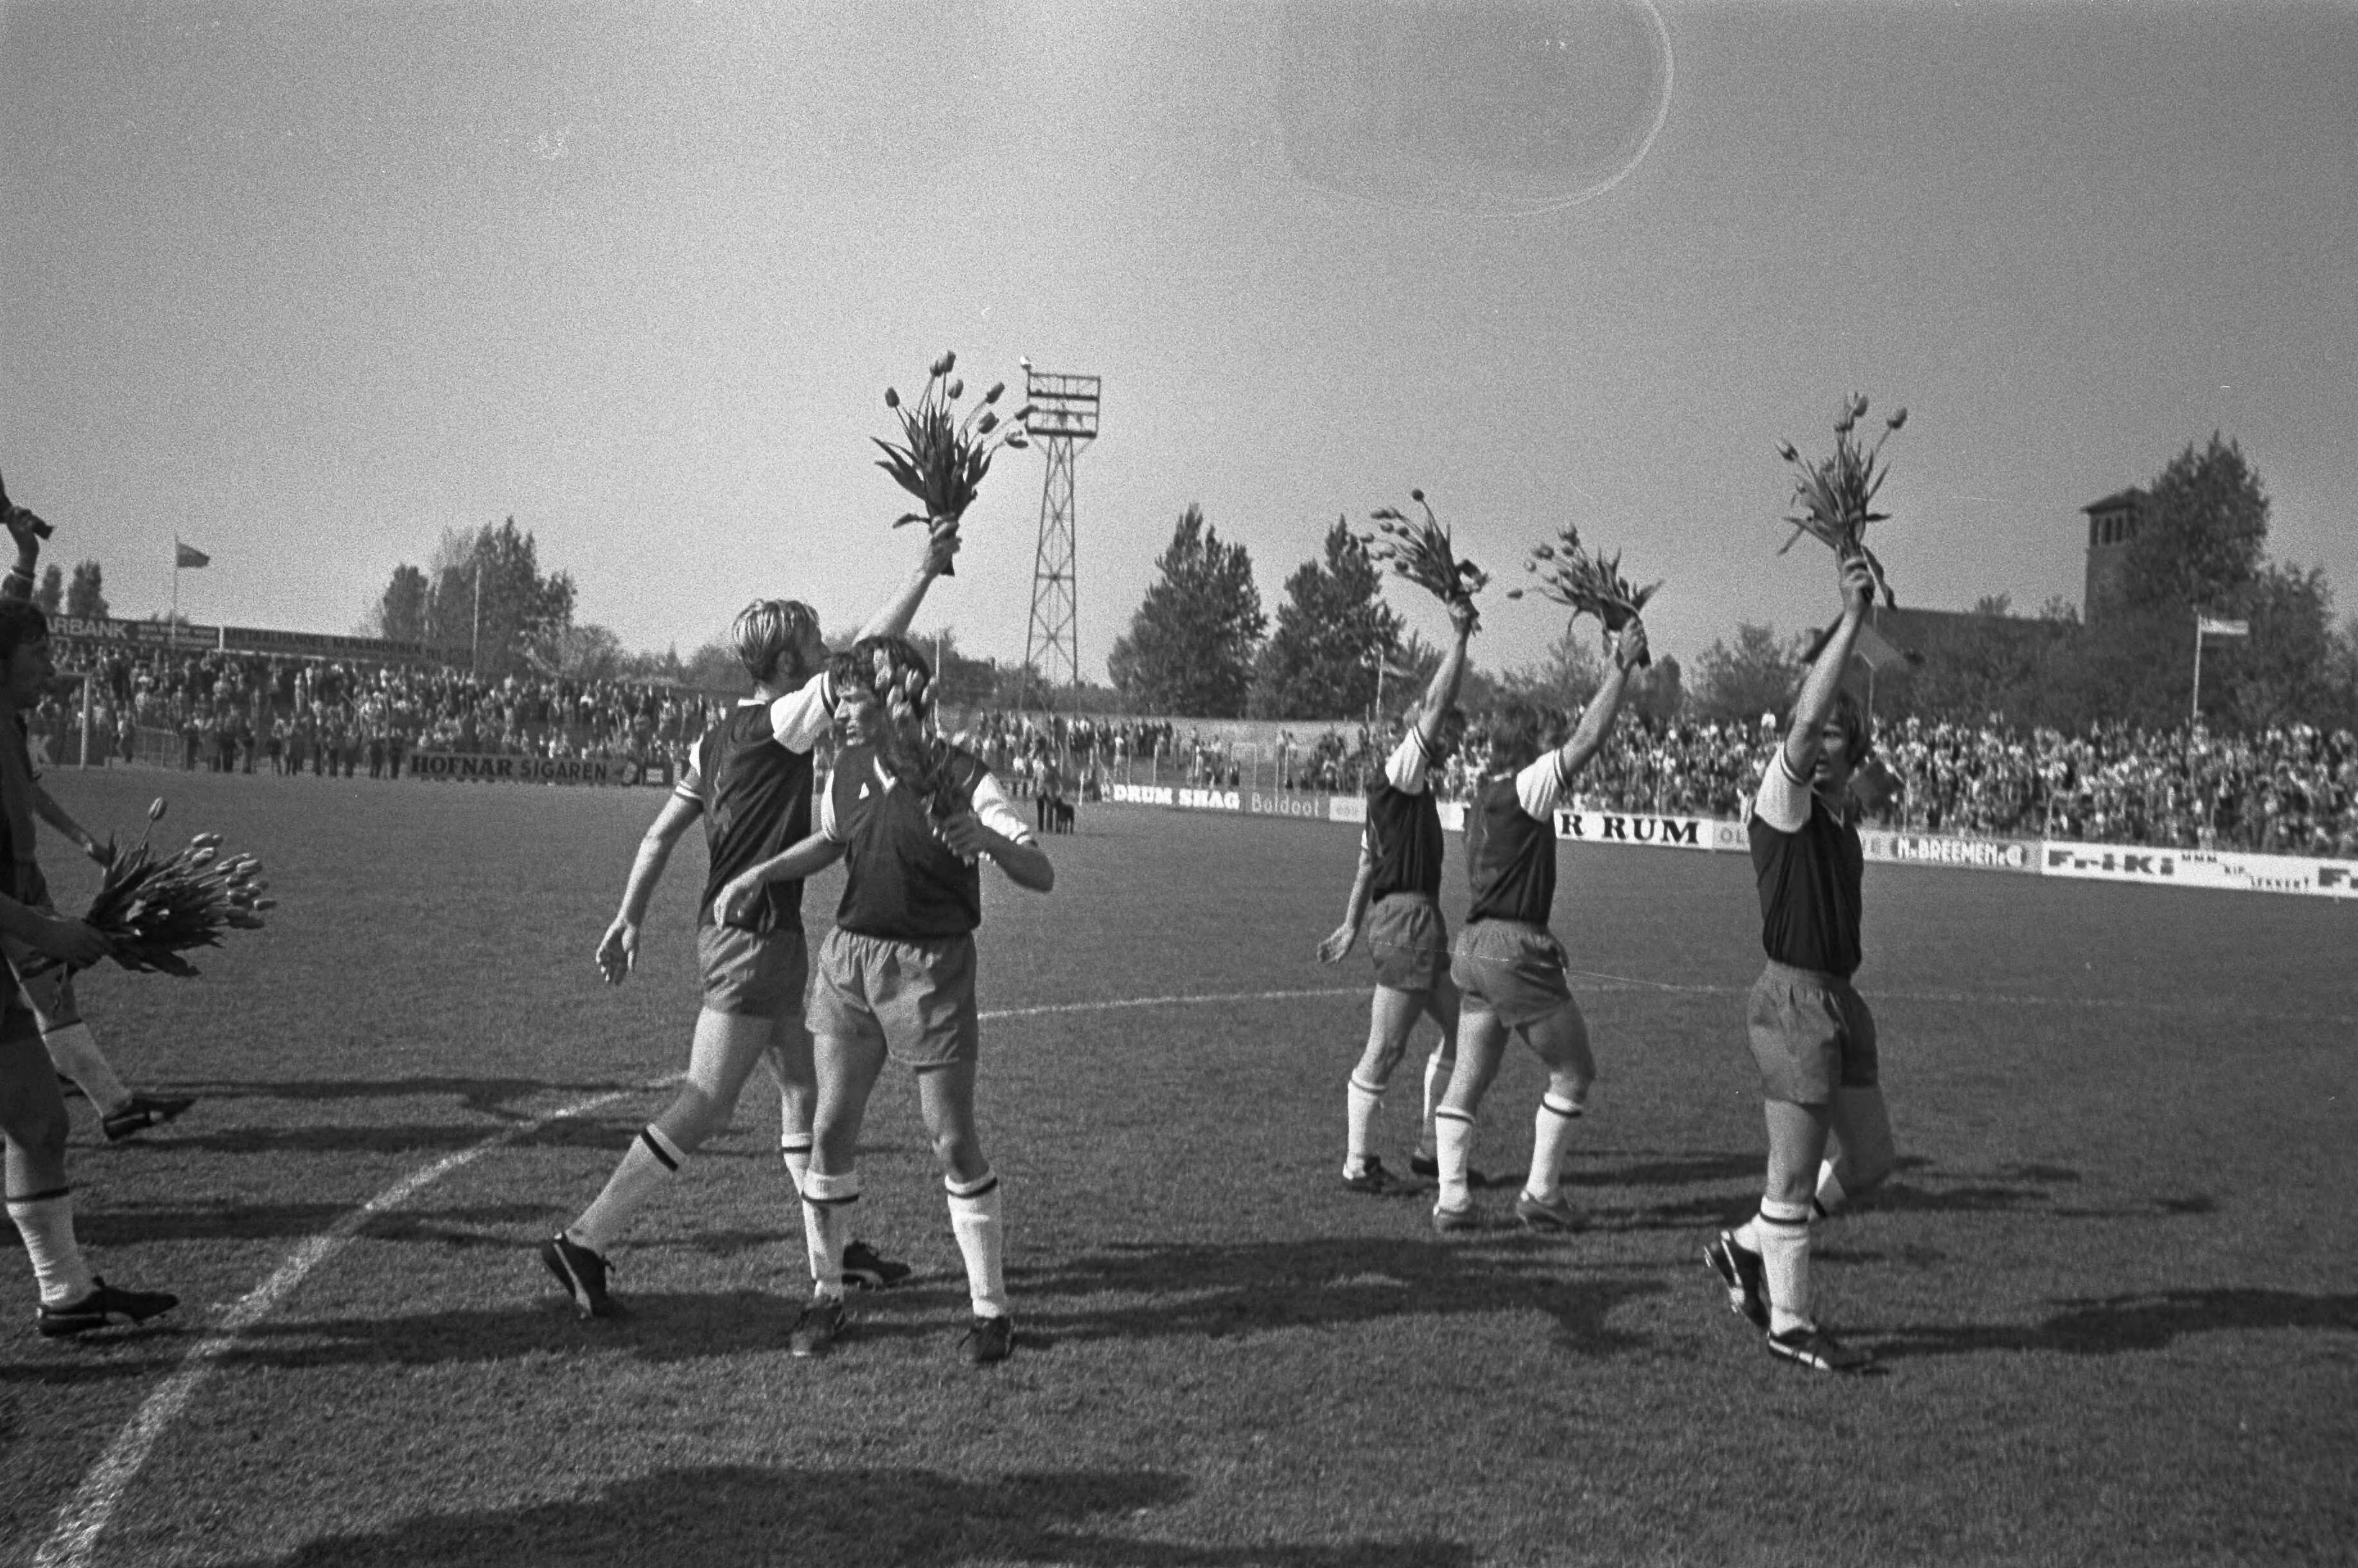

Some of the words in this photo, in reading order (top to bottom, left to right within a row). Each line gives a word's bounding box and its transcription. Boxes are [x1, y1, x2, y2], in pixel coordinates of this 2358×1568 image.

[412, 756, 513, 776] HOFNAR
[520, 760, 606, 781] SIGAREN
[1113, 784, 1172, 804] DRUM
[1179, 788, 1240, 809] SHAG
[1603, 816, 1699, 844] RUM
